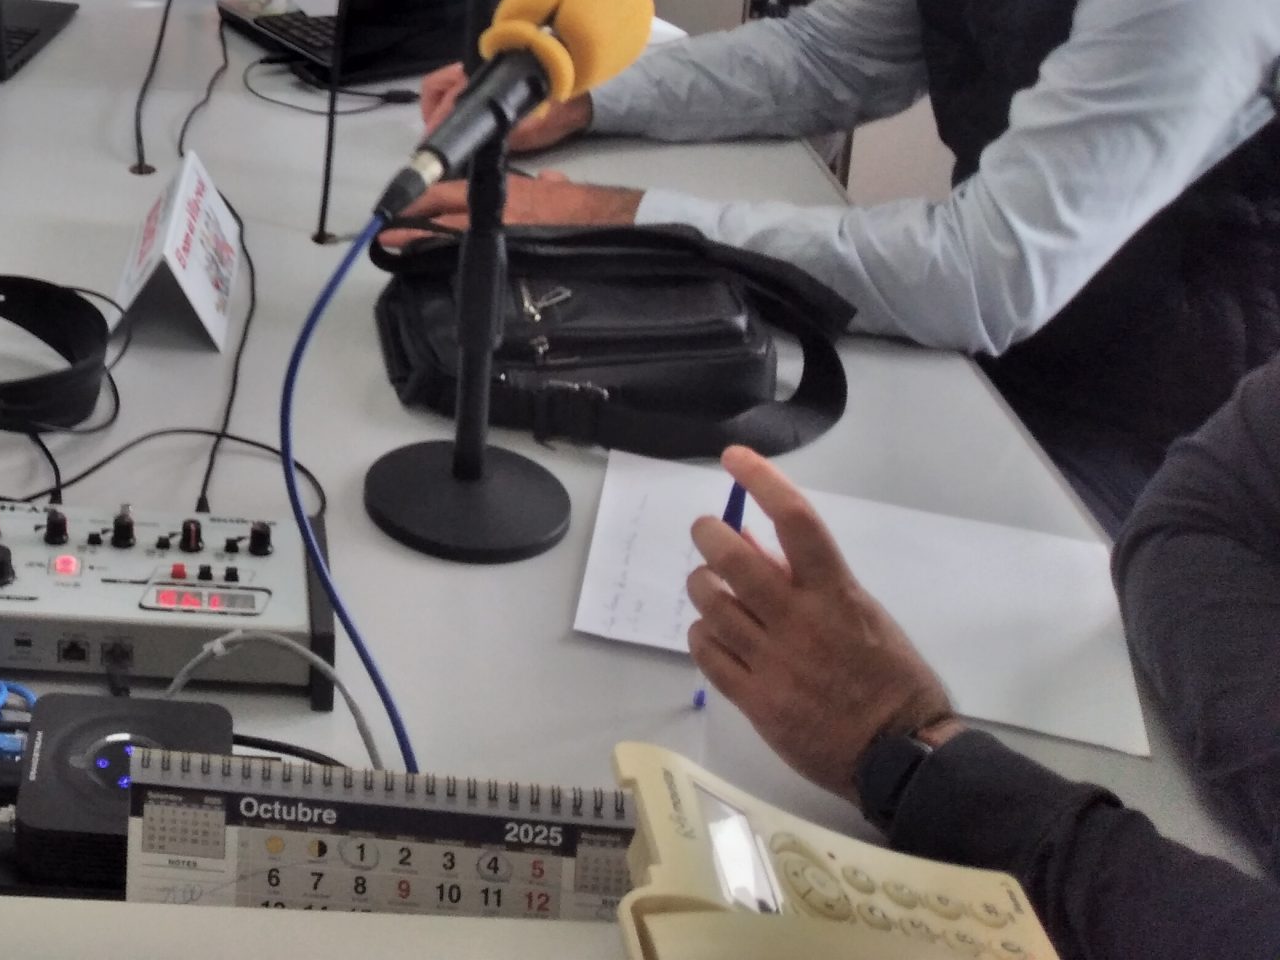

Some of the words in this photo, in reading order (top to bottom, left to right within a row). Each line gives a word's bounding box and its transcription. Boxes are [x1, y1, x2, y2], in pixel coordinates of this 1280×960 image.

[240, 797, 337, 824] Octubre
[505, 823, 562, 846] 2025
[356, 843, 365, 862] 1
[398, 847, 412, 867] 2
[442, 851, 456, 871] 3
[486, 856, 500, 875] 4
[531, 860, 545, 879] 5
[267, 867, 280, 887] 6
[310, 871, 325, 891] 7
[353, 876, 367, 895] 8
[397, 879, 411, 900] 9
[435, 883, 462, 904] 10
[480, 887, 502, 908] 11
[525, 891, 551, 912] 12
